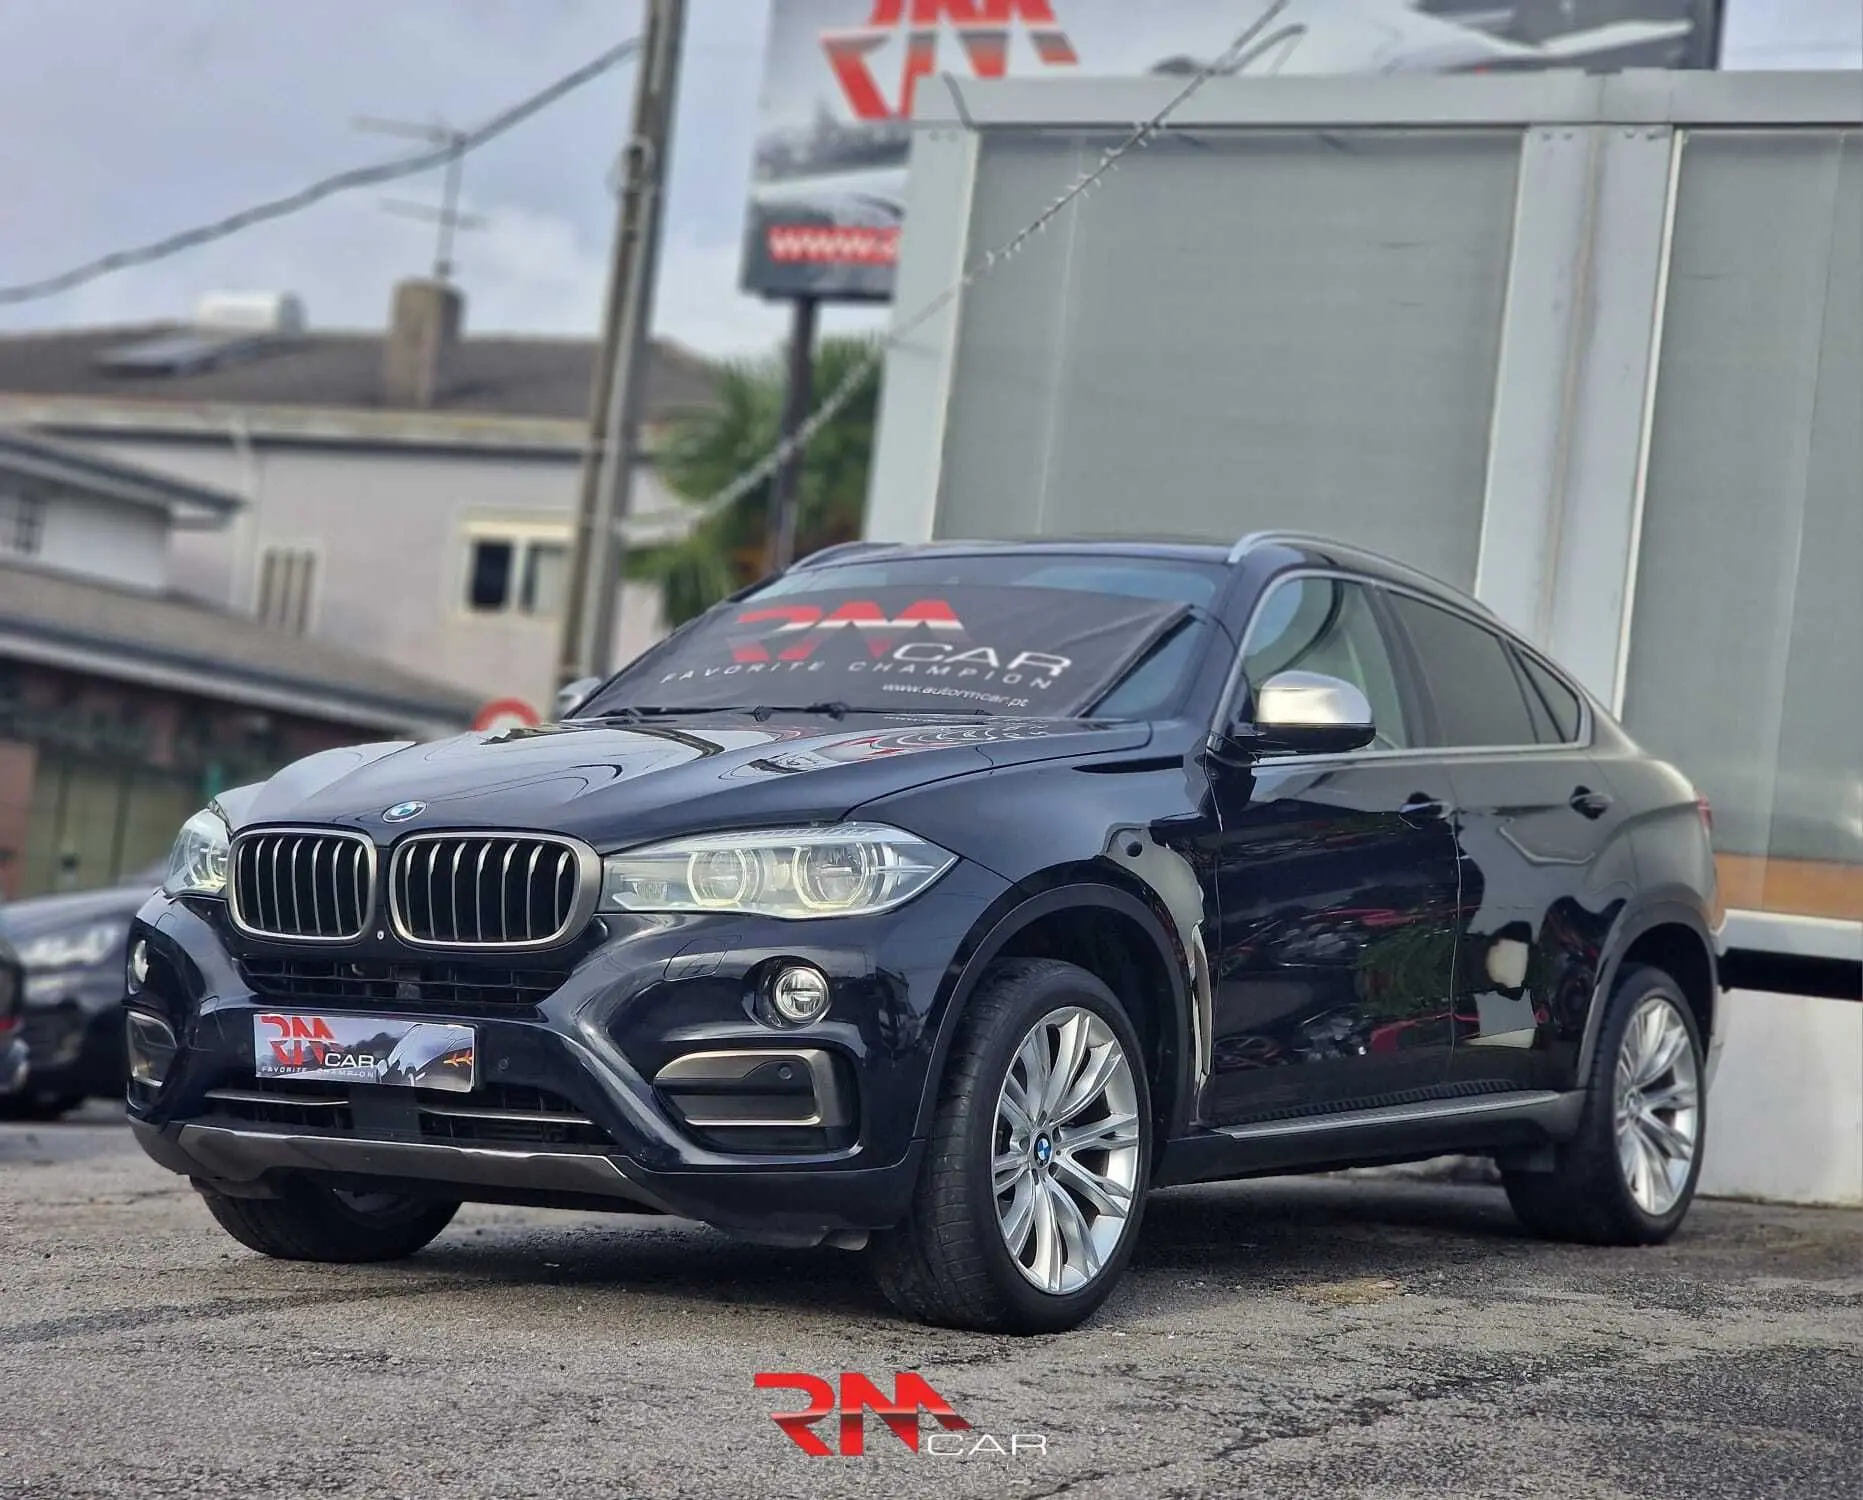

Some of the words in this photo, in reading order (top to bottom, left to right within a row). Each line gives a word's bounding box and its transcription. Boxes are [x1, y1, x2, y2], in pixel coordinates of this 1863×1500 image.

[659, 660, 825, 684] FAVORITE
[848, 661, 1052, 690] CHAMPION
[893, 642, 1072, 677] CAR
[882, 683, 1029, 707] www.autormcar.pt
[260, 1016, 344, 1065] RM
[325, 1053, 374, 1068] CAR
